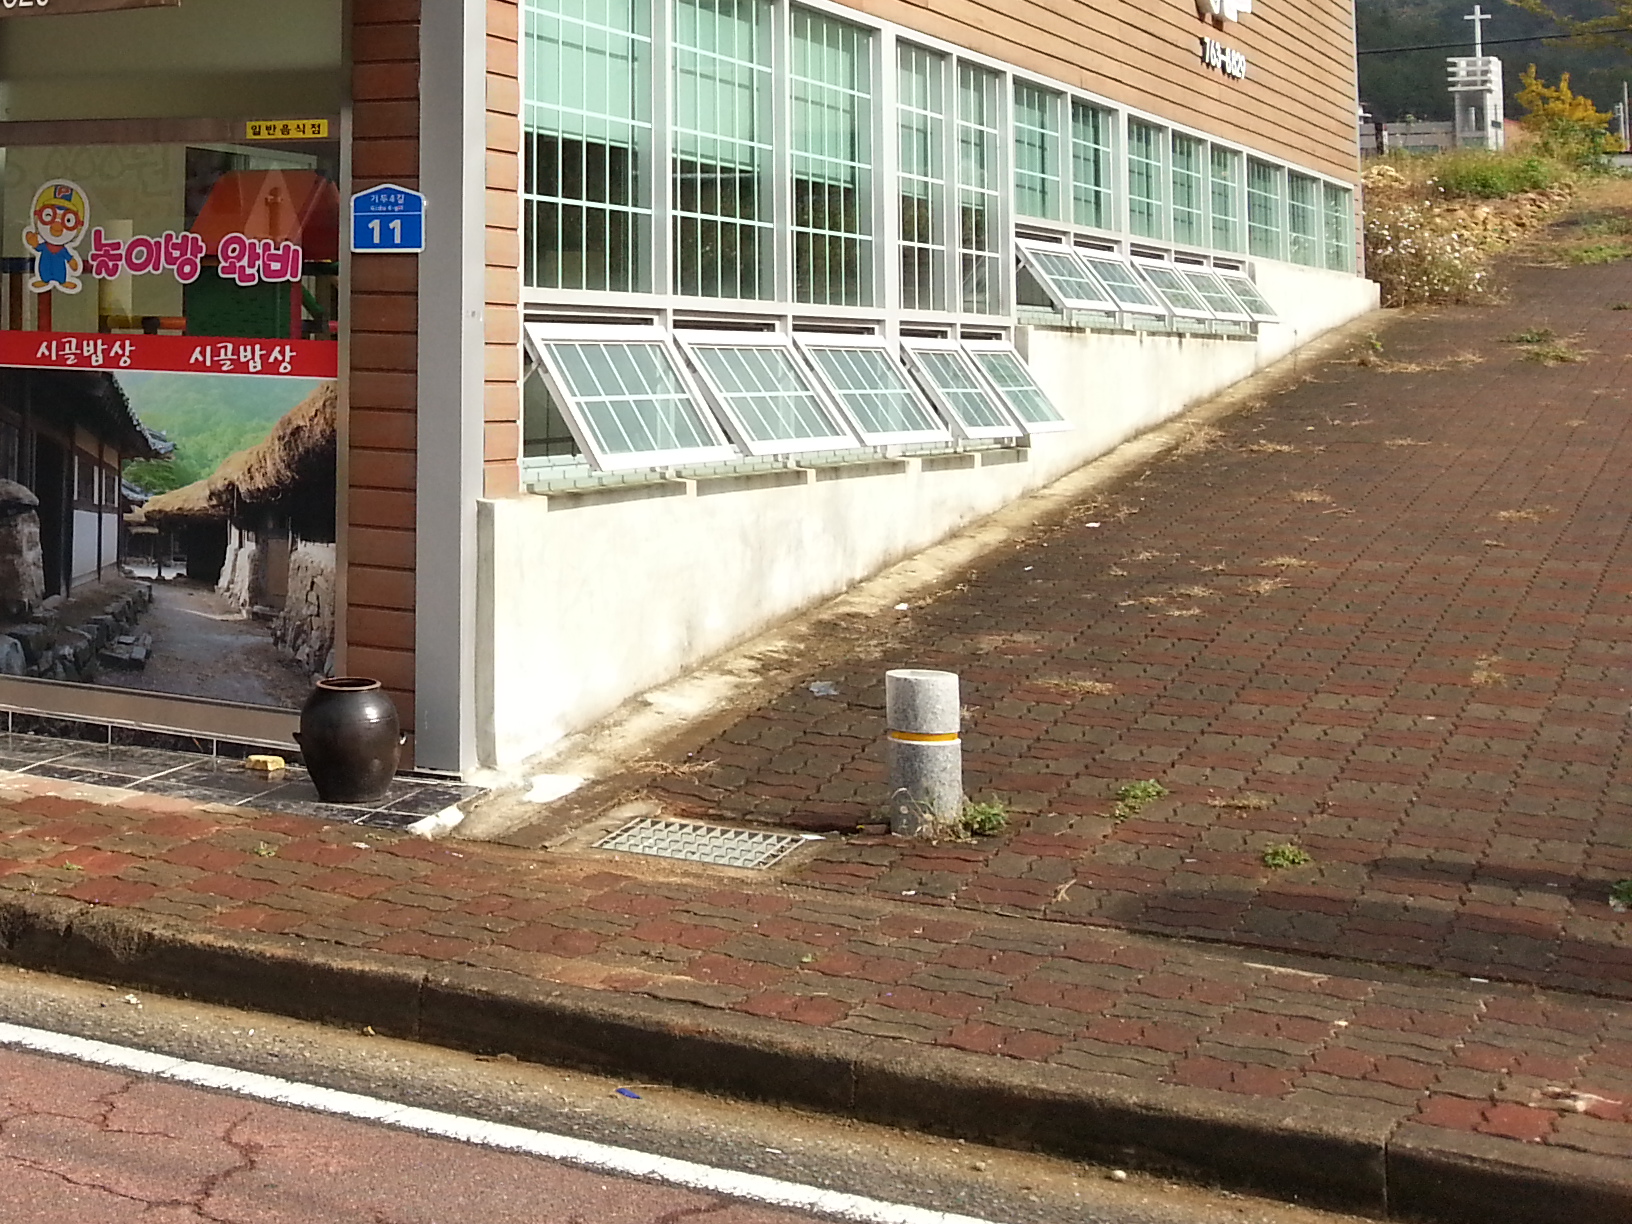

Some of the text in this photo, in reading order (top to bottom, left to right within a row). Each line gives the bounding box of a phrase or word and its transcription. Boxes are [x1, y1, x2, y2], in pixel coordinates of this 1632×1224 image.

[251, 123, 321, 136] 일반음식점
[368, 219, 402, 244] 11
[90, 227, 302, 285] 놀이방 완비
[36, 337, 136, 367] 시골밥상
[189, 342, 297, 374] 시골밥상
